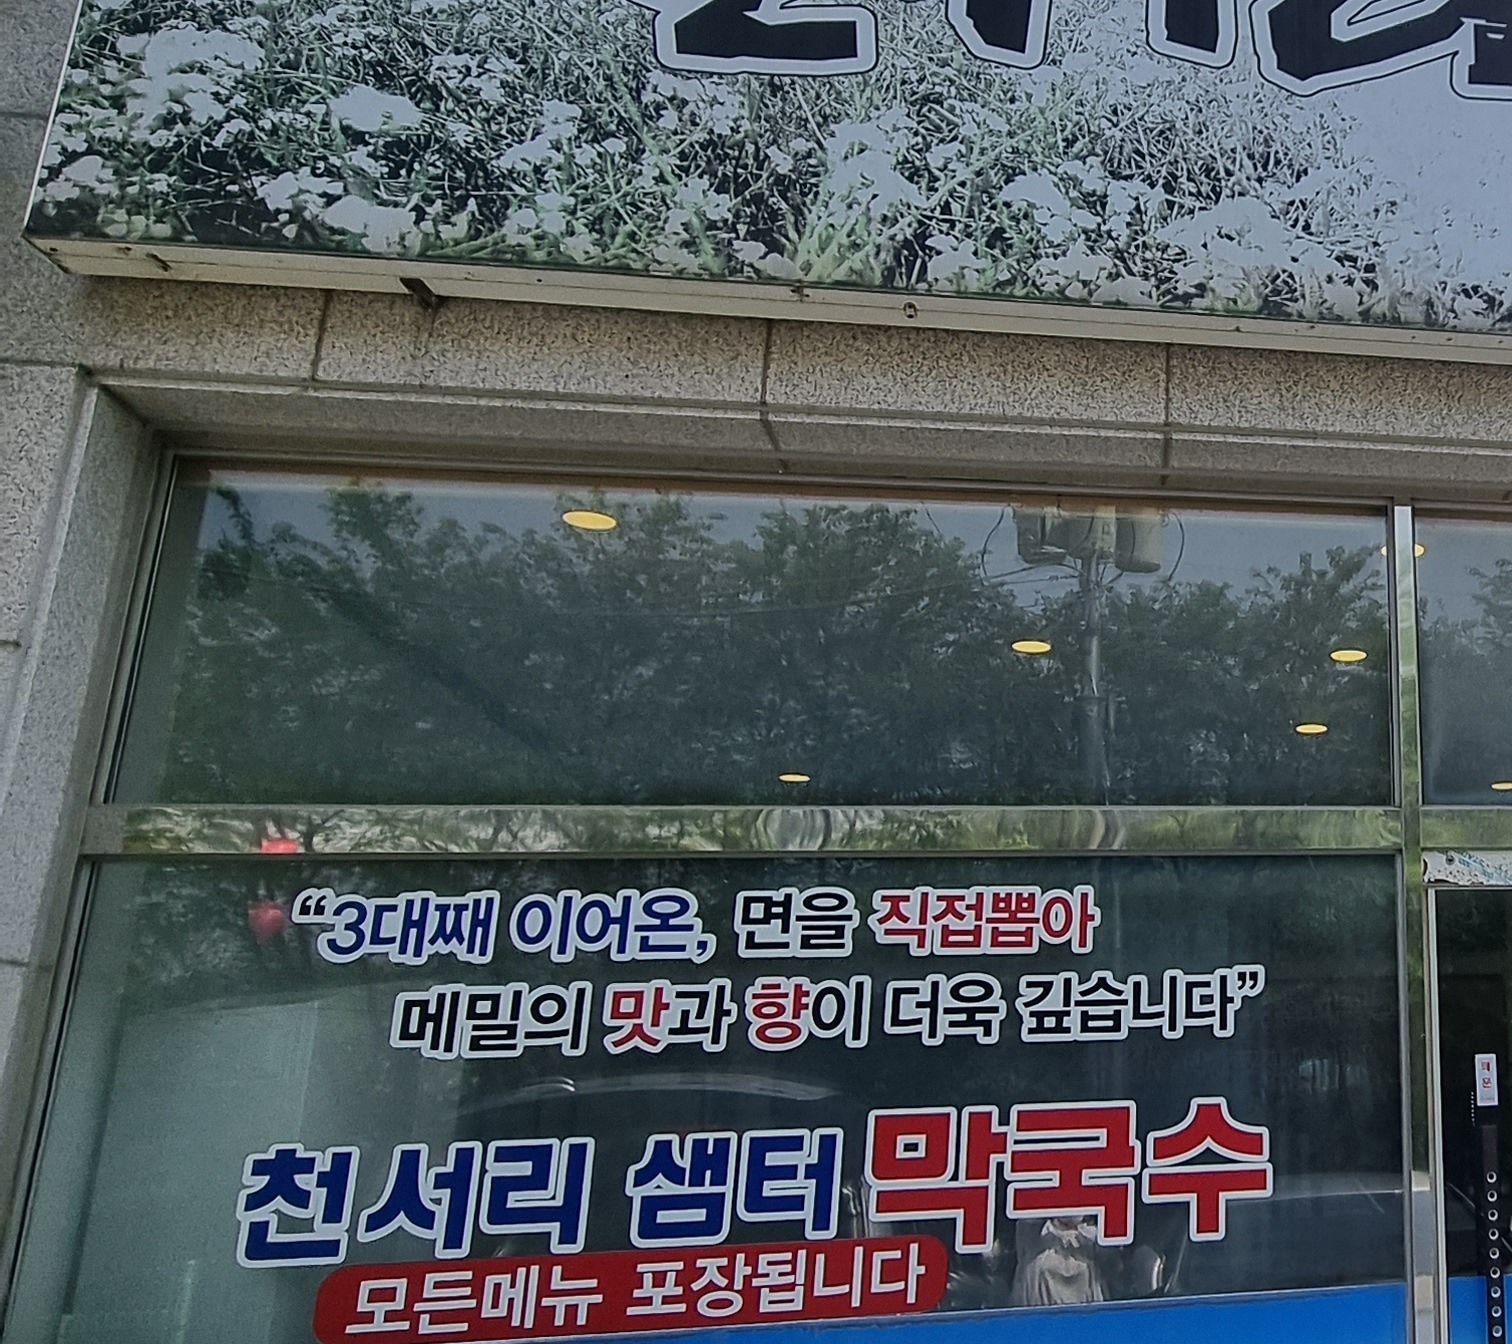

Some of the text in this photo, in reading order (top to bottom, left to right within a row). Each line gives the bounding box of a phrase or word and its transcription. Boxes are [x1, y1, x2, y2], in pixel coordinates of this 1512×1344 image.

[511, 889, 714, 961] 이어온,
[738, 888, 853, 956] 면을
[871, 886, 1099, 954] 직접뽑아
[392, 982, 591, 1058] 메밀의
[604, 979, 735, 1052] 맛과
[747, 976, 871, 1047] 향이
[884, 973, 1003, 1043] 더욱
[239, 1098, 1271, 1266] 천서리 샘터 막국수
[343, 1243, 926, 1336] 모든메뉴 포장됩니다
